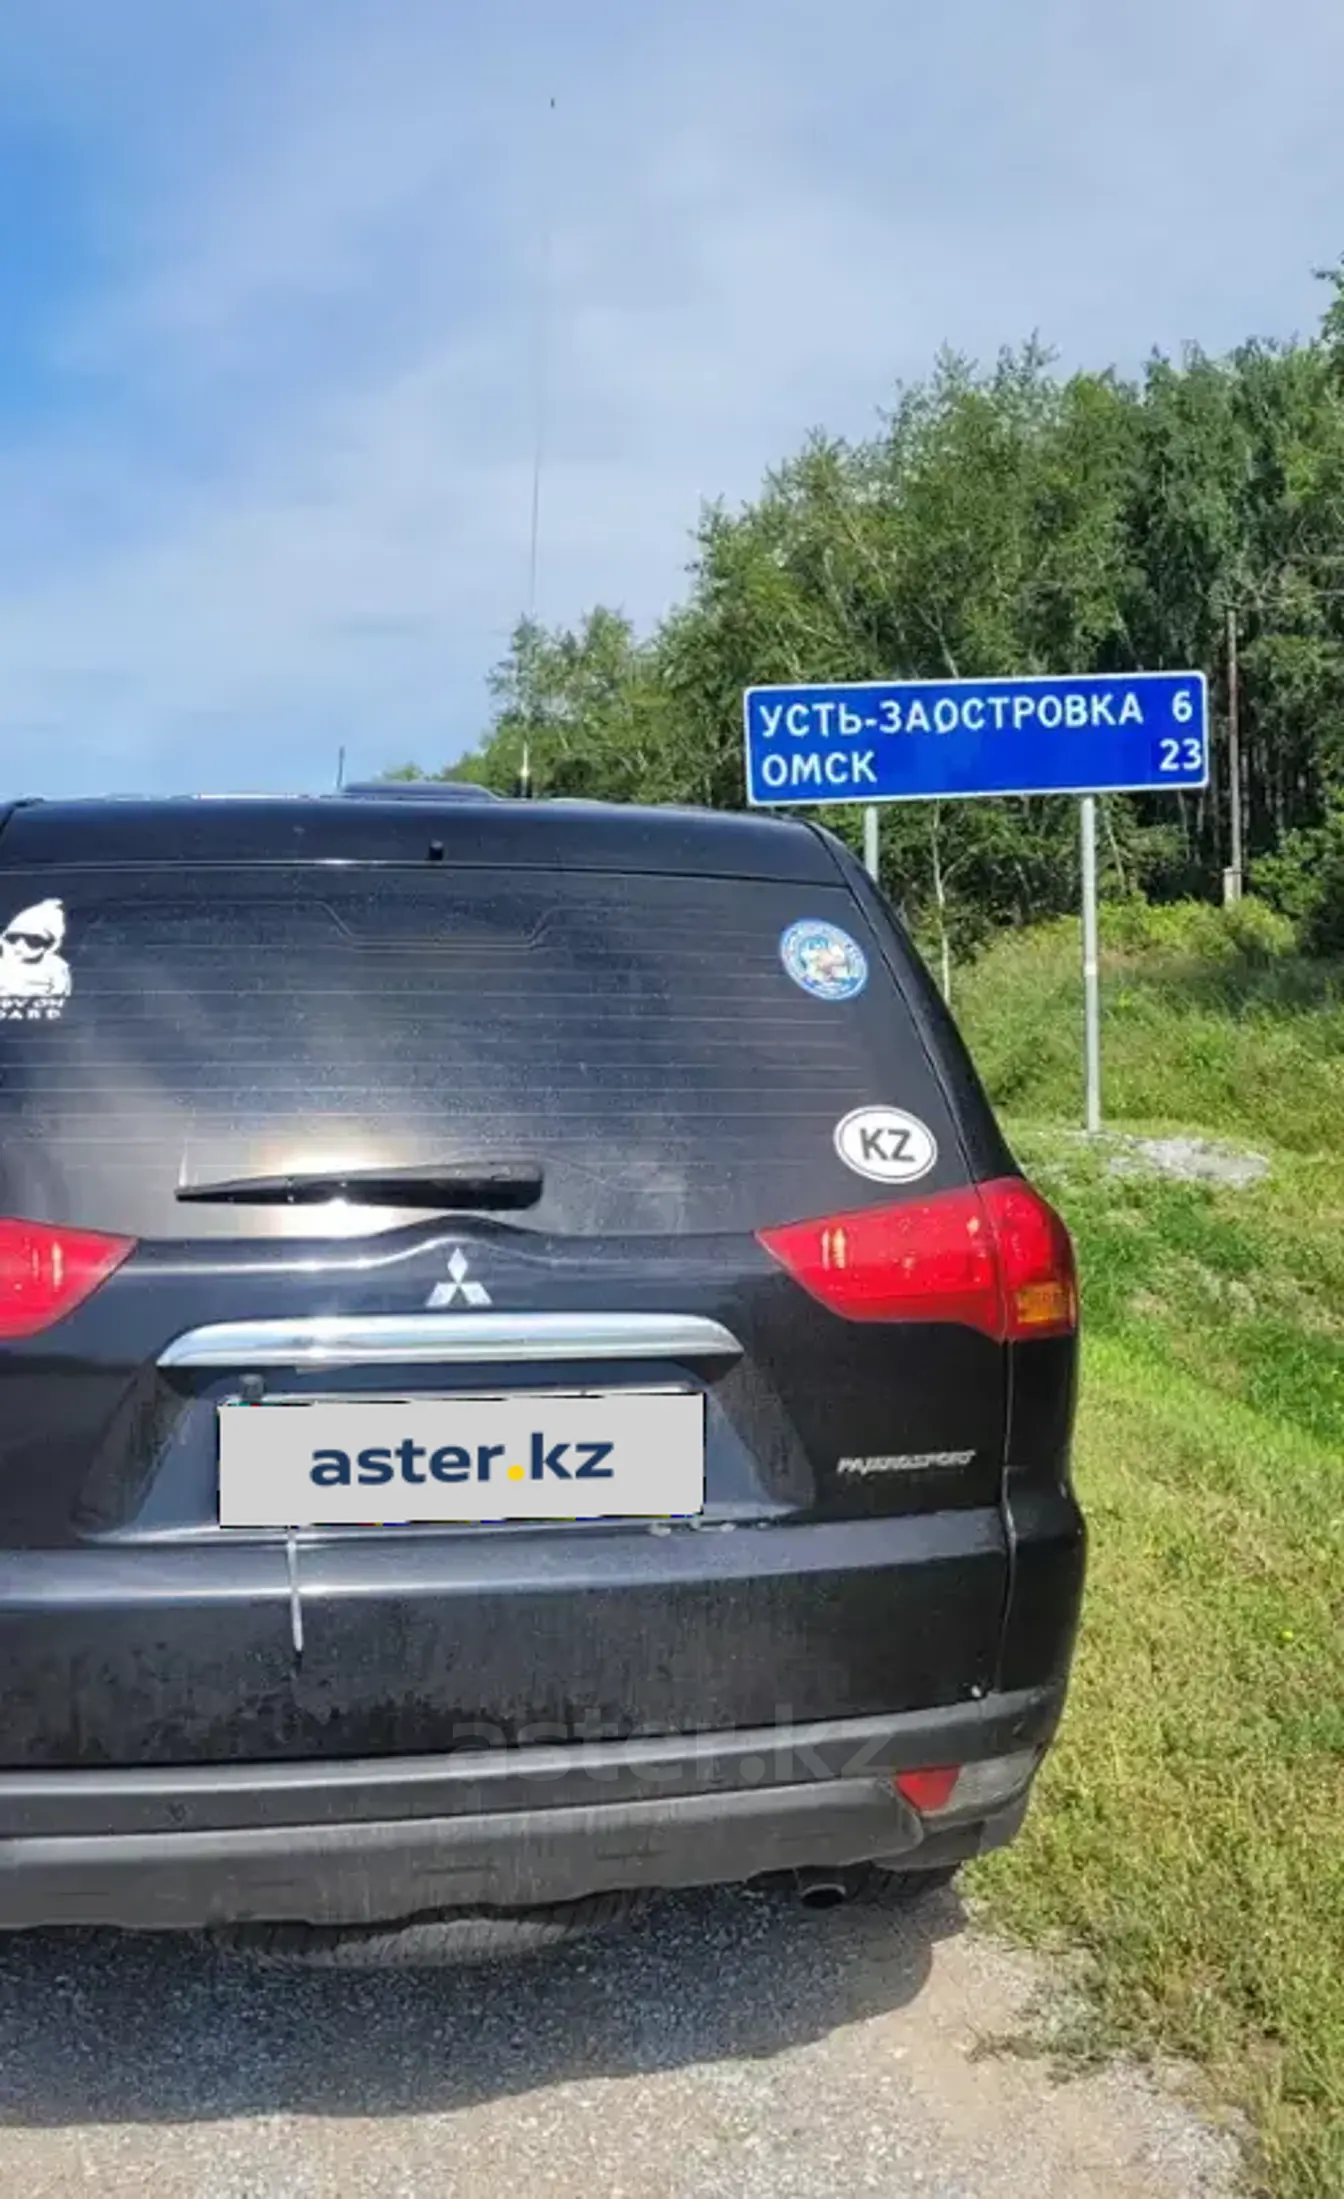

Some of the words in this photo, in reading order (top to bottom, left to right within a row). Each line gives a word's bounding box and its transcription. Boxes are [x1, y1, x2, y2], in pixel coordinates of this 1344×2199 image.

[759, 692, 1144, 738] УСТЬ-ЗАОСТРОВКА
[1171, 690, 1193, 723] 6
[761, 750, 878, 787] ОМСК
[1158, 738, 1202, 772] 23
[859, 1127, 916, 1162] KZ
